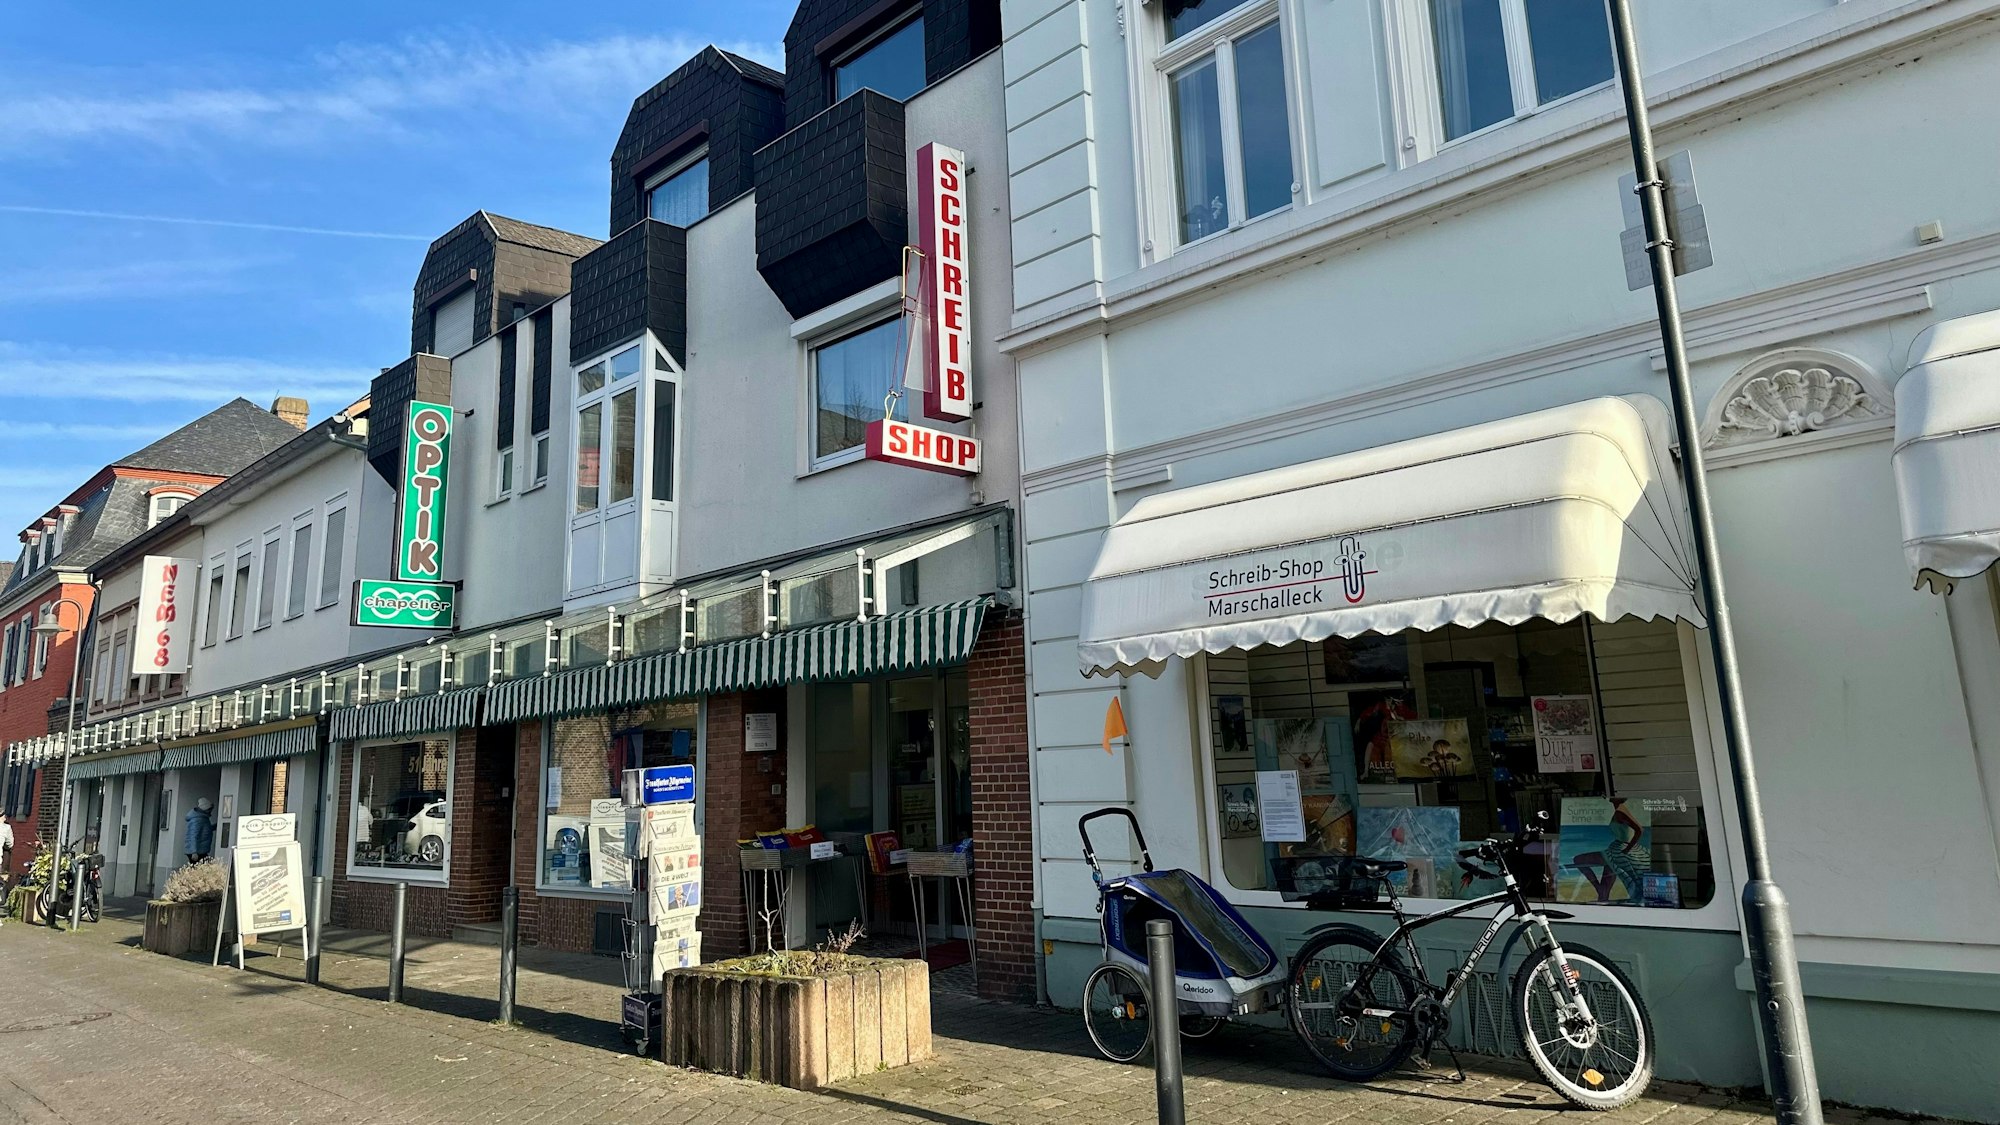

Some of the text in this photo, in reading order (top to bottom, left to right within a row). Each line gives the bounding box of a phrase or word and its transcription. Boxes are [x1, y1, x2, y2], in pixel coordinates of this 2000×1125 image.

[940, 158, 965, 401] SCHREIB
[888, 424, 976, 466] SHOP
[410, 409, 449, 575] OPTIK
[1208, 559, 1324, 589] Schreib-Shop
[364, 594, 451, 611] chapelier
[1208, 585, 1323, 617] Marschalleck
[153, 628, 171, 667] 68
[1540, 737, 1573, 757] DUFT
[1567, 804, 1607, 816] Summer
[1571, 815, 1592, 823] time
[1183, 982, 1214, 994] Qeridoo
